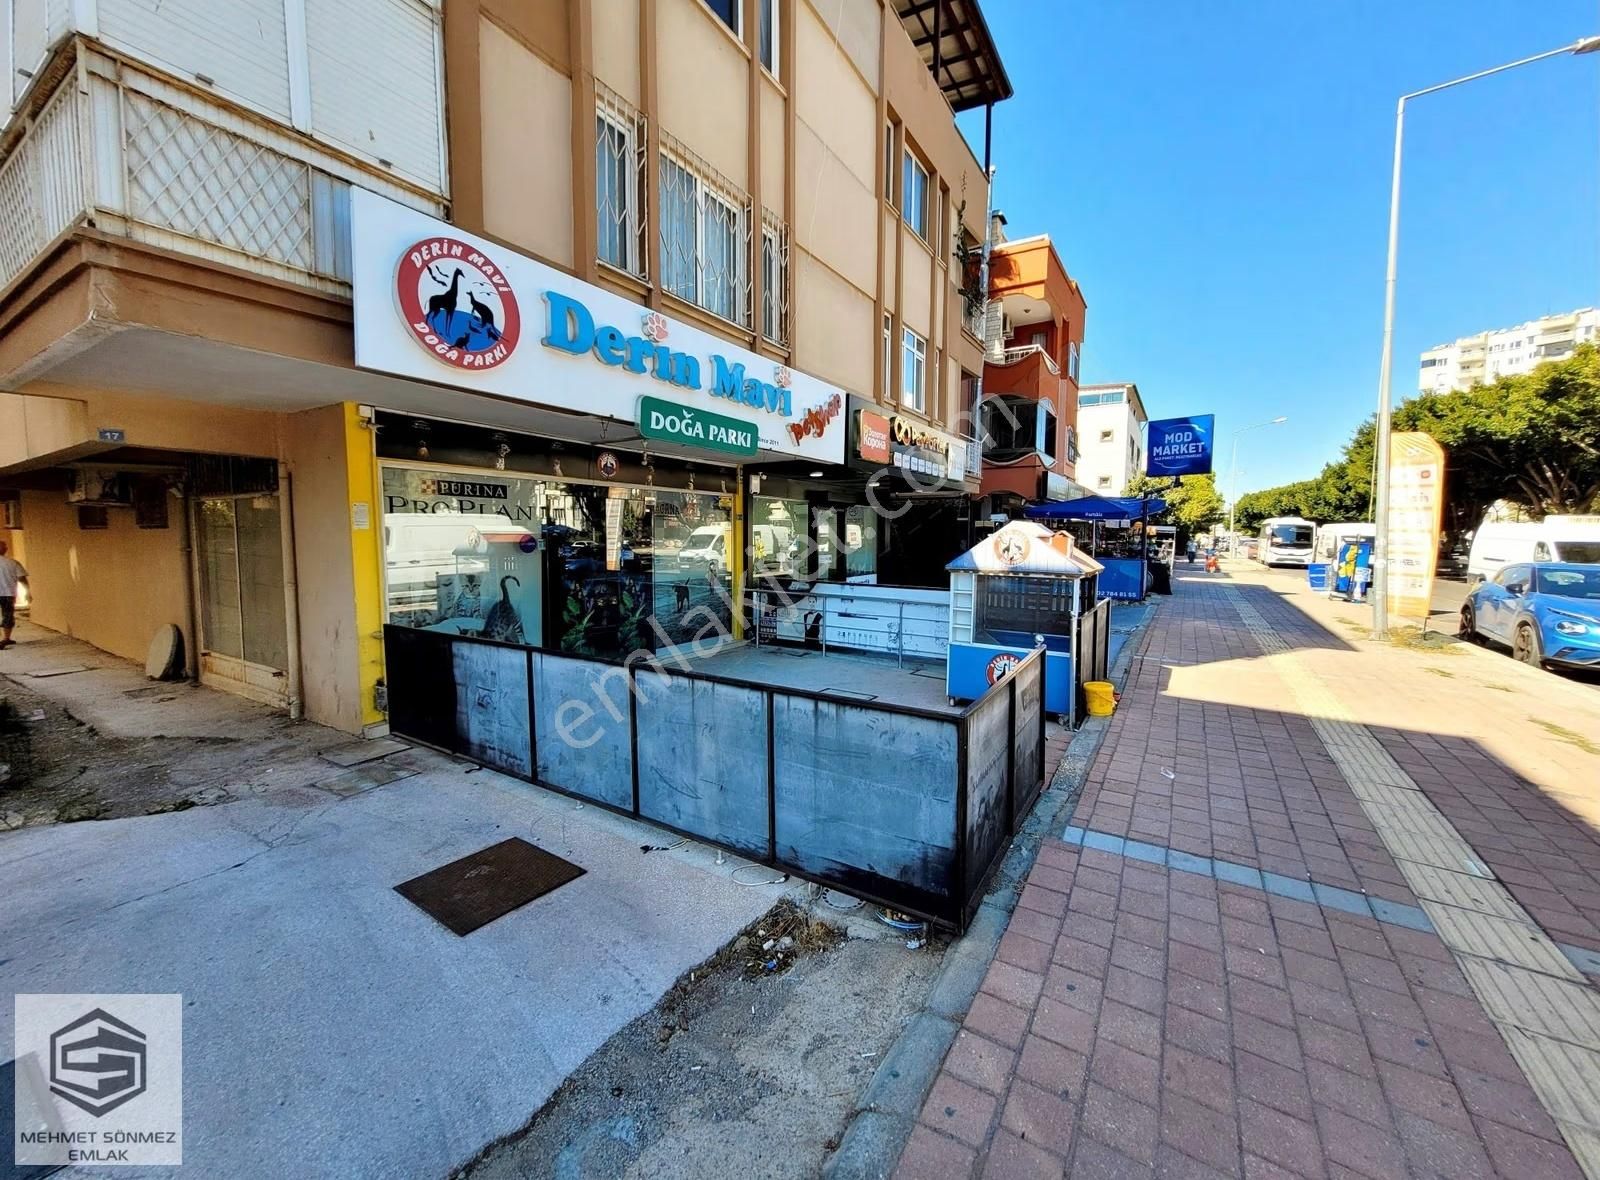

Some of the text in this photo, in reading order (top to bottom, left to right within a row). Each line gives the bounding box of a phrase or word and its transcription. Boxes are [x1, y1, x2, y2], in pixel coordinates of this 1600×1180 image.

[411, 239, 511, 292] DERİN MAVİ
[413, 321, 508, 367] DOĞA PARKI
[541, 290, 792, 417] Derin Mavi
[105, 431, 119, 440] 17
[650, 408, 751, 448] DOĞA PARKI
[769, 438, 780, 446] 2011
[863, 431, 887, 450] Корона
[1165, 431, 1193, 444] MOD
[1153, 442, 1205, 457] MARKET
[439, 481, 506, 498] PURINA
